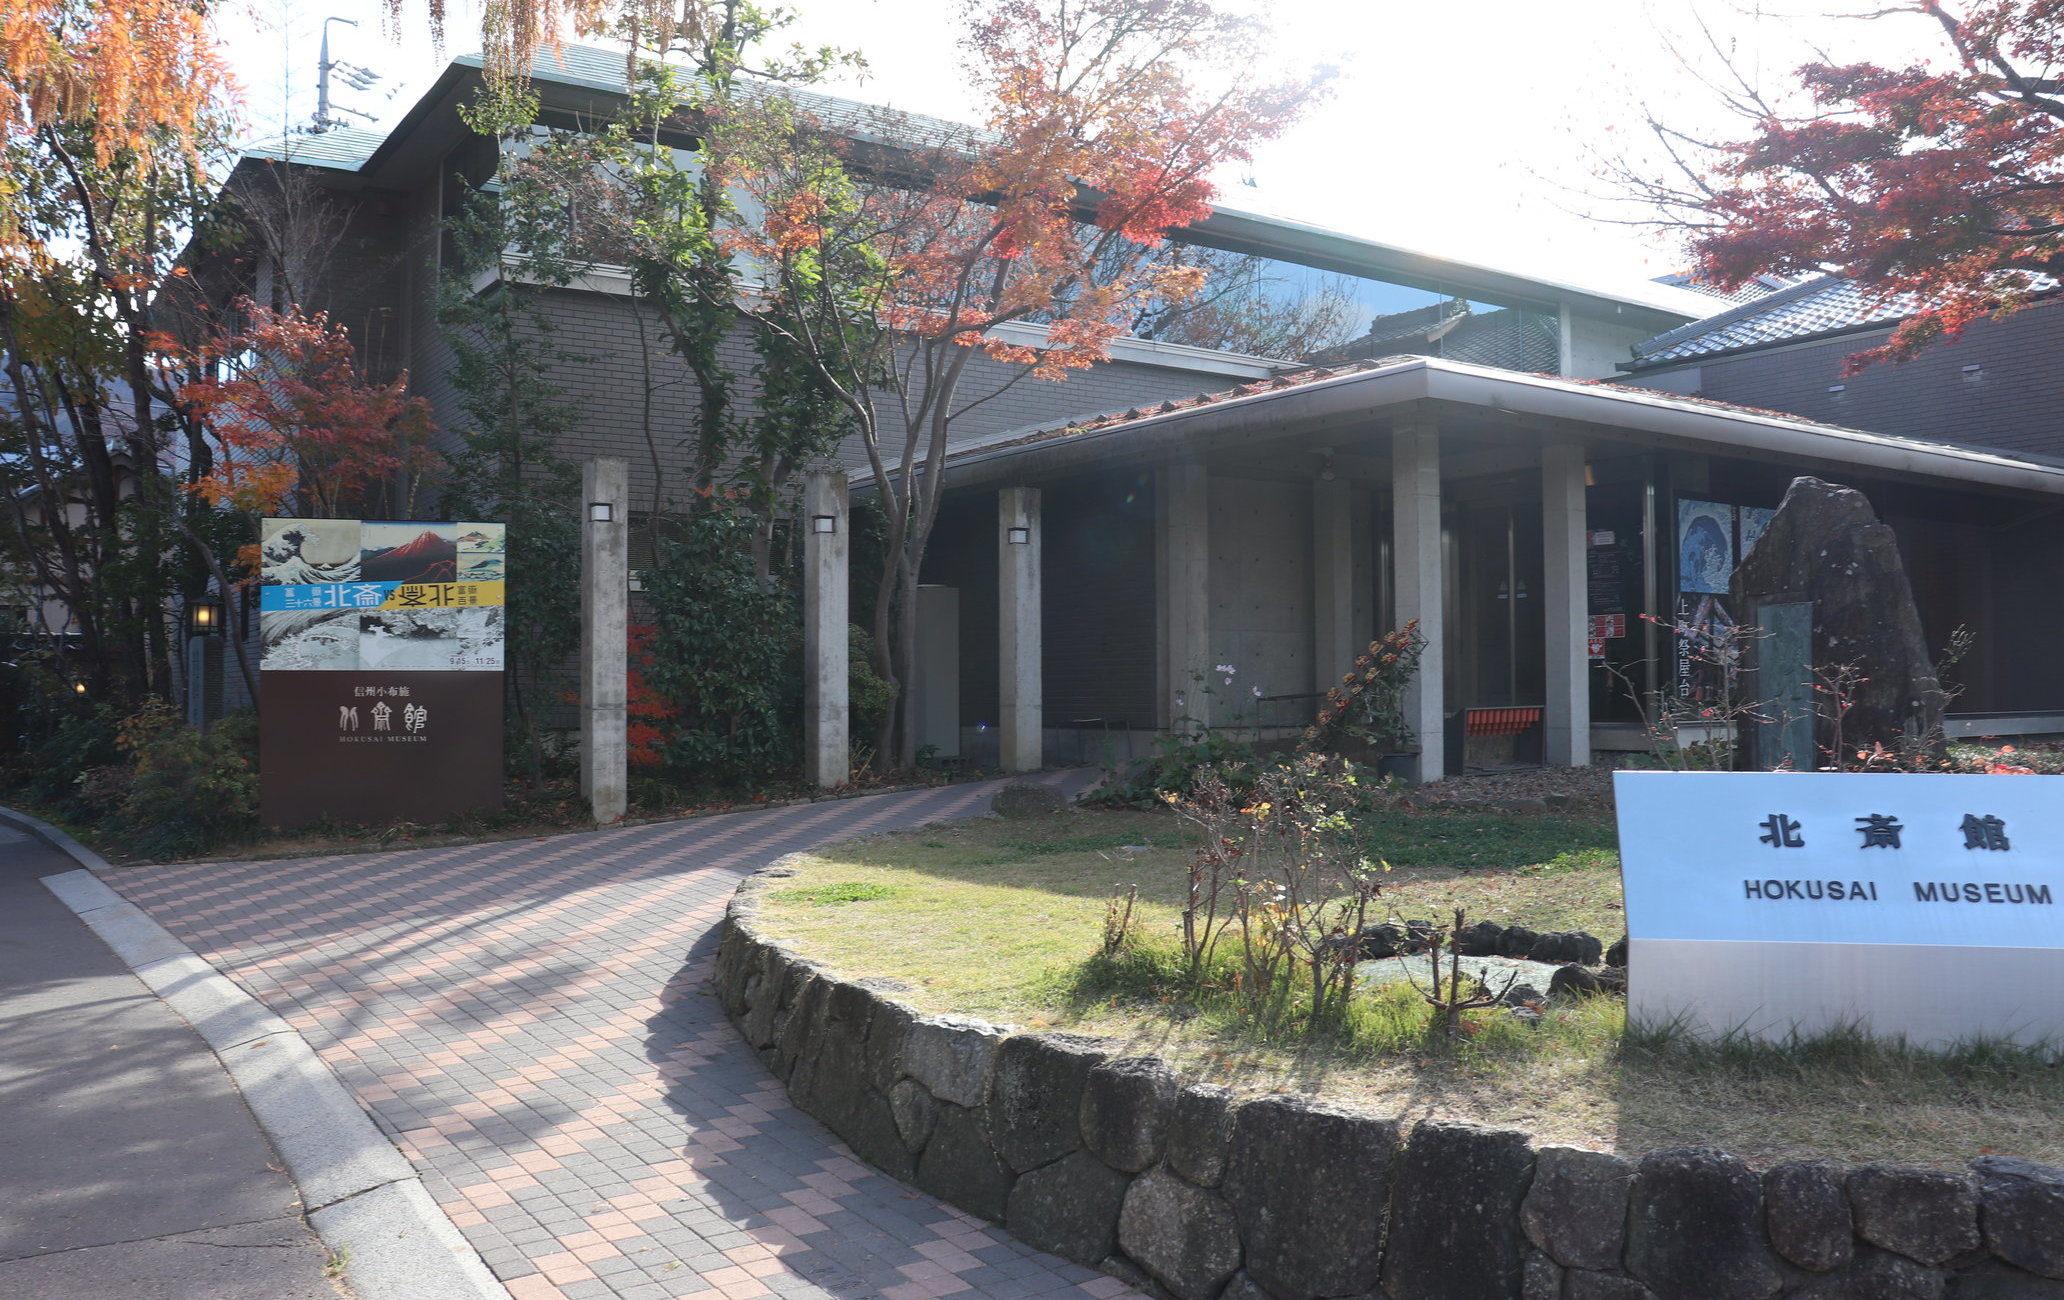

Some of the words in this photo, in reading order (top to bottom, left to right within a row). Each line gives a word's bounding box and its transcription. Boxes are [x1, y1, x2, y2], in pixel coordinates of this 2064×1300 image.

[324, 584, 382, 607] 北斎
[354, 686, 410, 697] 信州小布施
[339, 735, 385, 743] HOKUSAI
[387, 735, 428, 743] MUSEUM
[1759, 813, 2010, 851] 北斎館
[1744, 879, 1878, 901] HOKUSAI
[1913, 881, 2053, 904] MUSEUM
